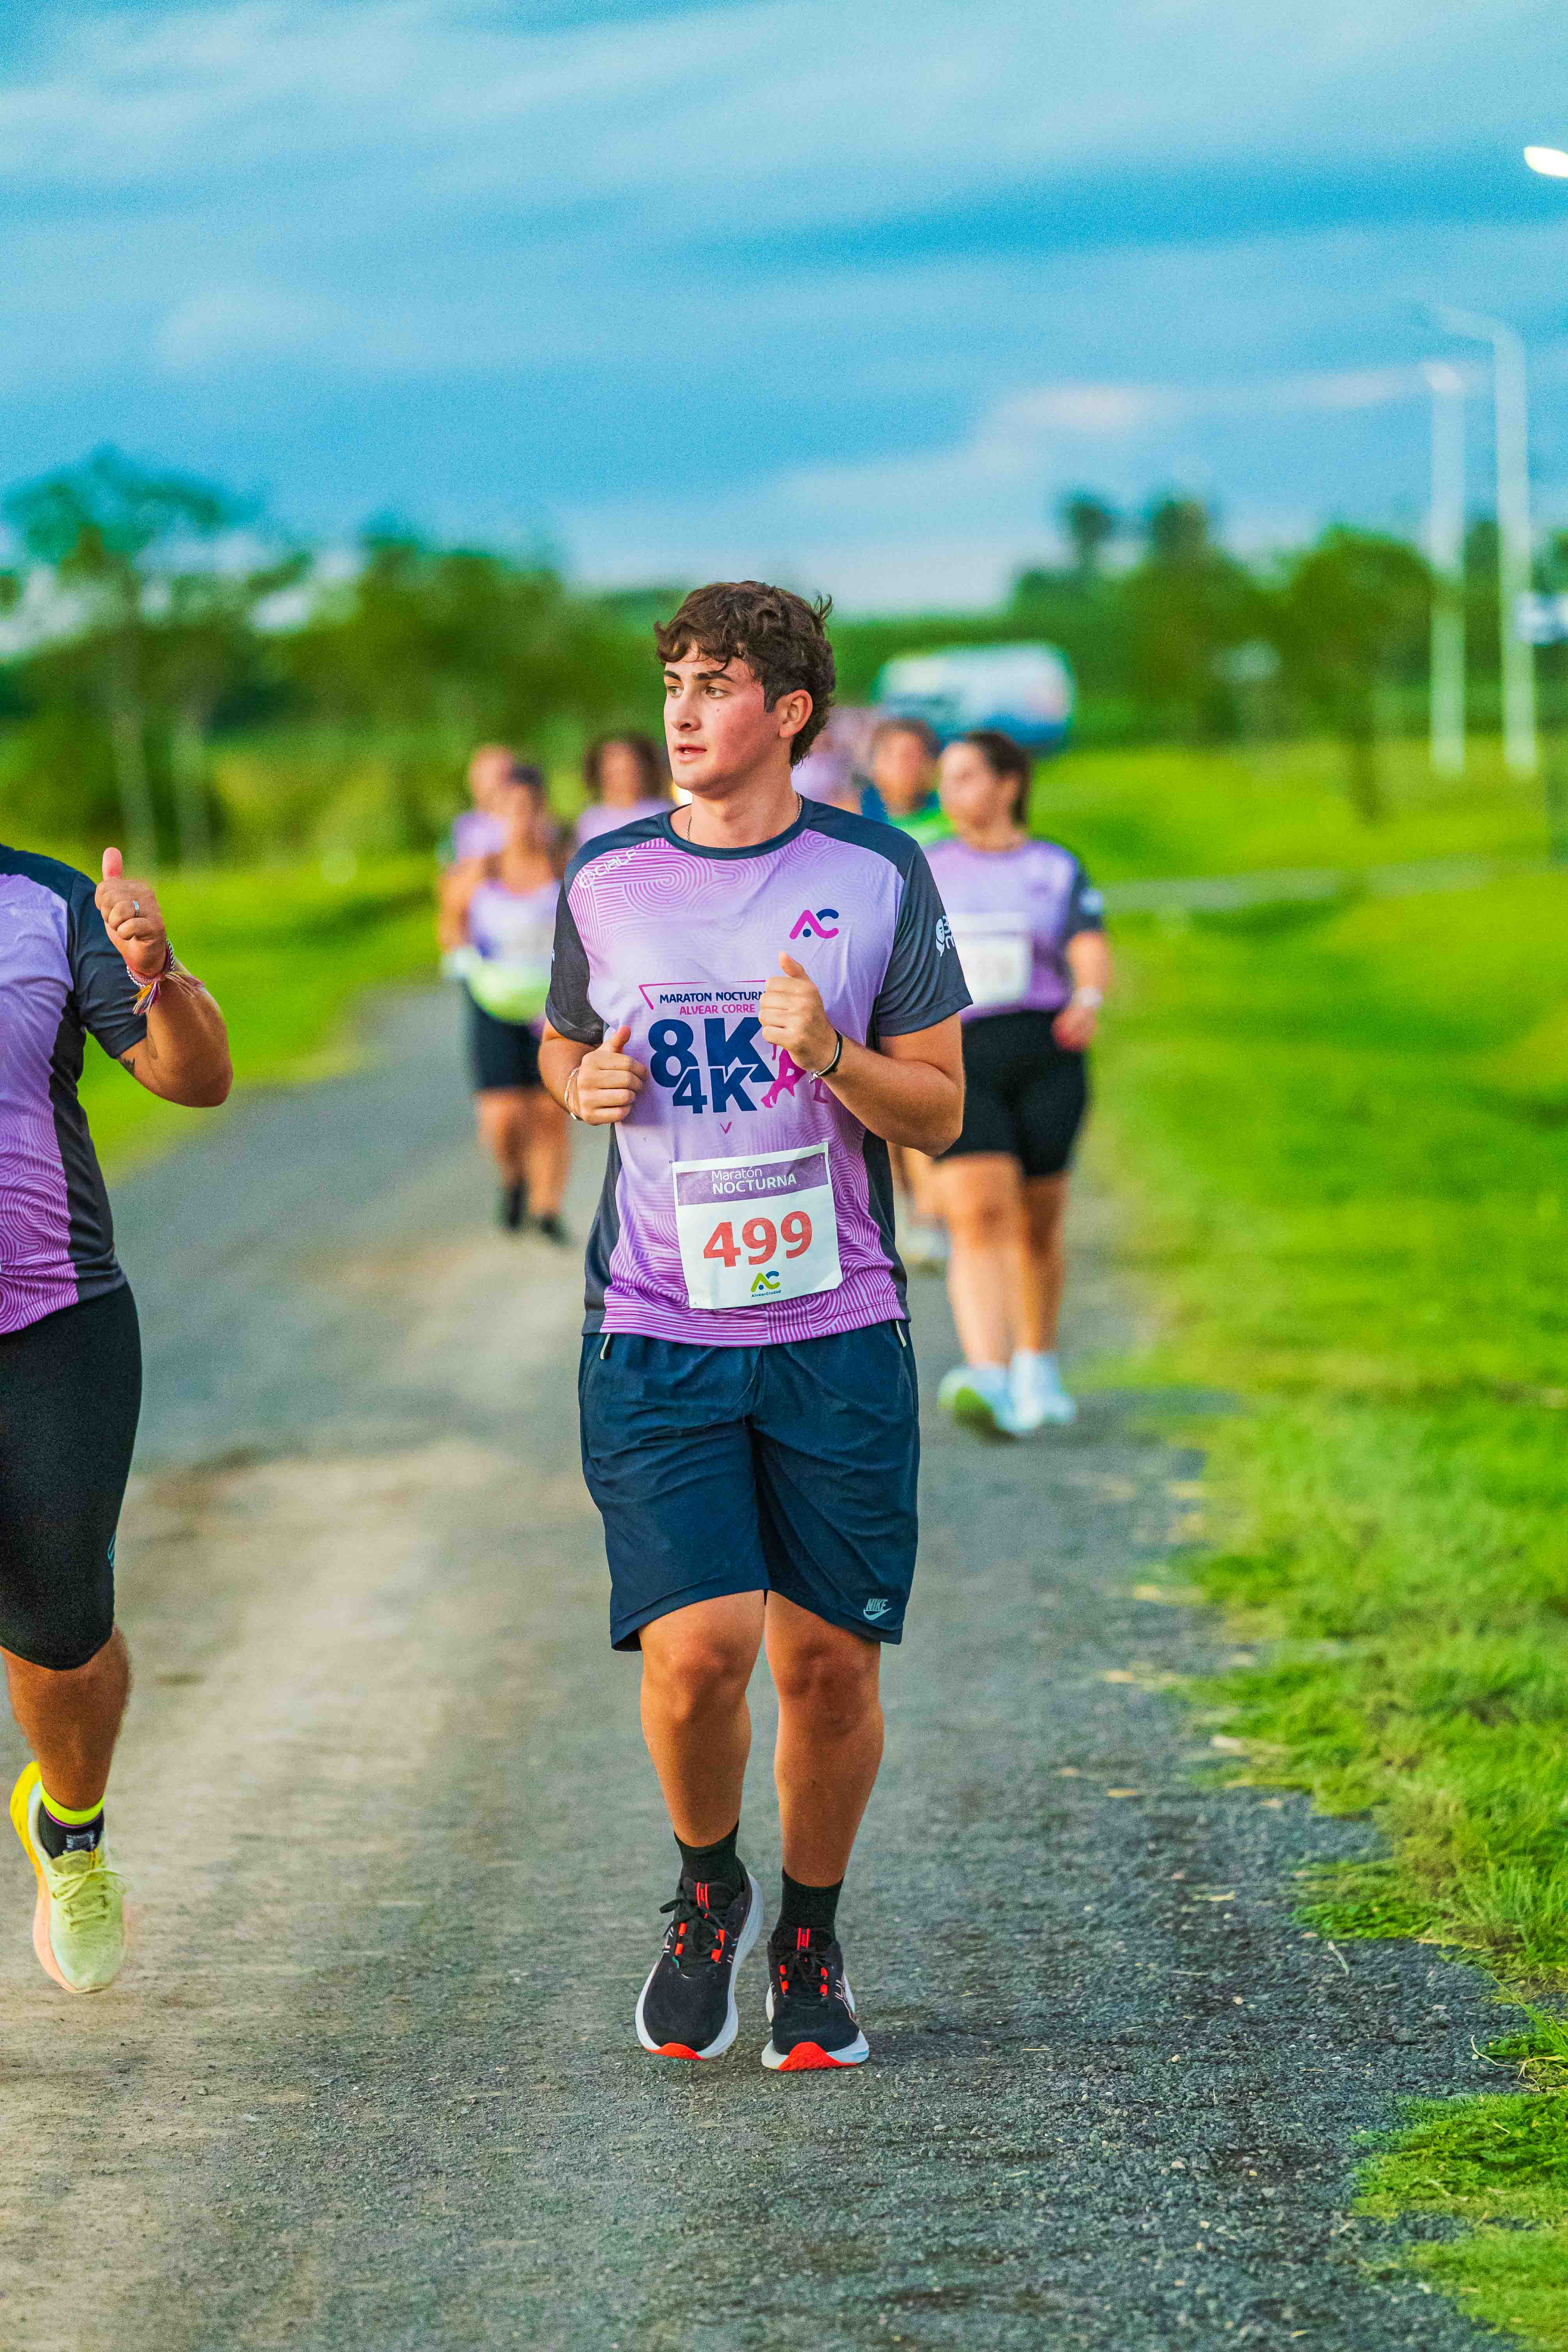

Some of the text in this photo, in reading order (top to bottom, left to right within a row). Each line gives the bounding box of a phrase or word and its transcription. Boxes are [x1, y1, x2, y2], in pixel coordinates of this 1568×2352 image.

[660, 993, 712, 1003] MARATON
[680, 1004, 755, 1015] ALVEAR CORRE
[648, 1017, 776, 1088] 8K
[673, 1067, 758, 1114] 4K
[711, 1167, 762, 1181] Maratón
[712, 1173, 796, 1195] NOCTURNA
[703, 1211, 812, 1267] 499
[751, 1289, 781, 1298] AlvearCiudad
[866, 1598, 888, 1610] NIKE
